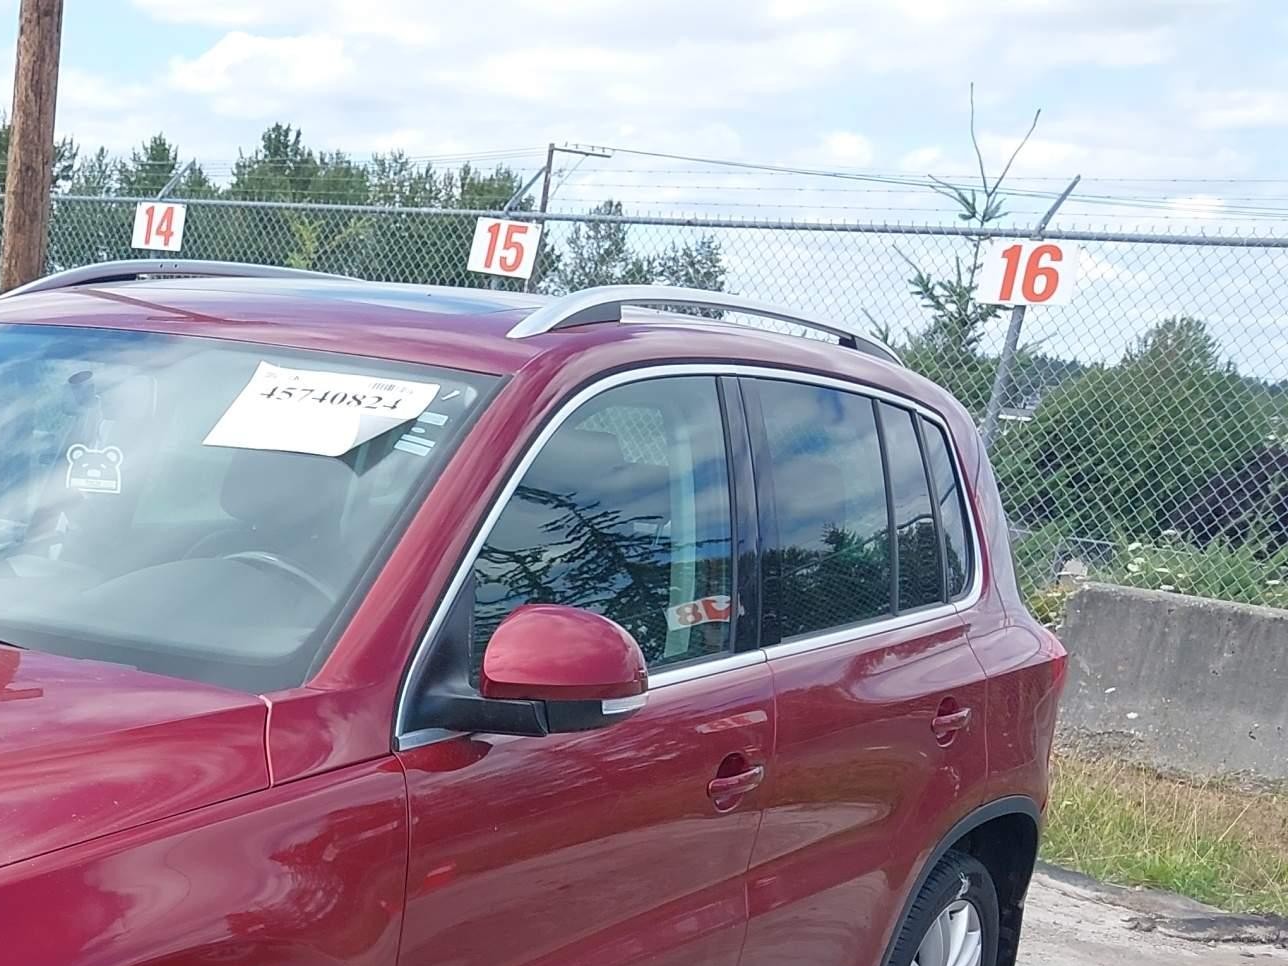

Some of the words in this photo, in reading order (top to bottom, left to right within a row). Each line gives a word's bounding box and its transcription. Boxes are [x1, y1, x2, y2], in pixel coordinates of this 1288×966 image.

[144, 206, 174, 247] 14
[484, 222, 529, 272] 15
[999, 244, 1063, 303] 16
[261, 386, 402, 410] 45740824
